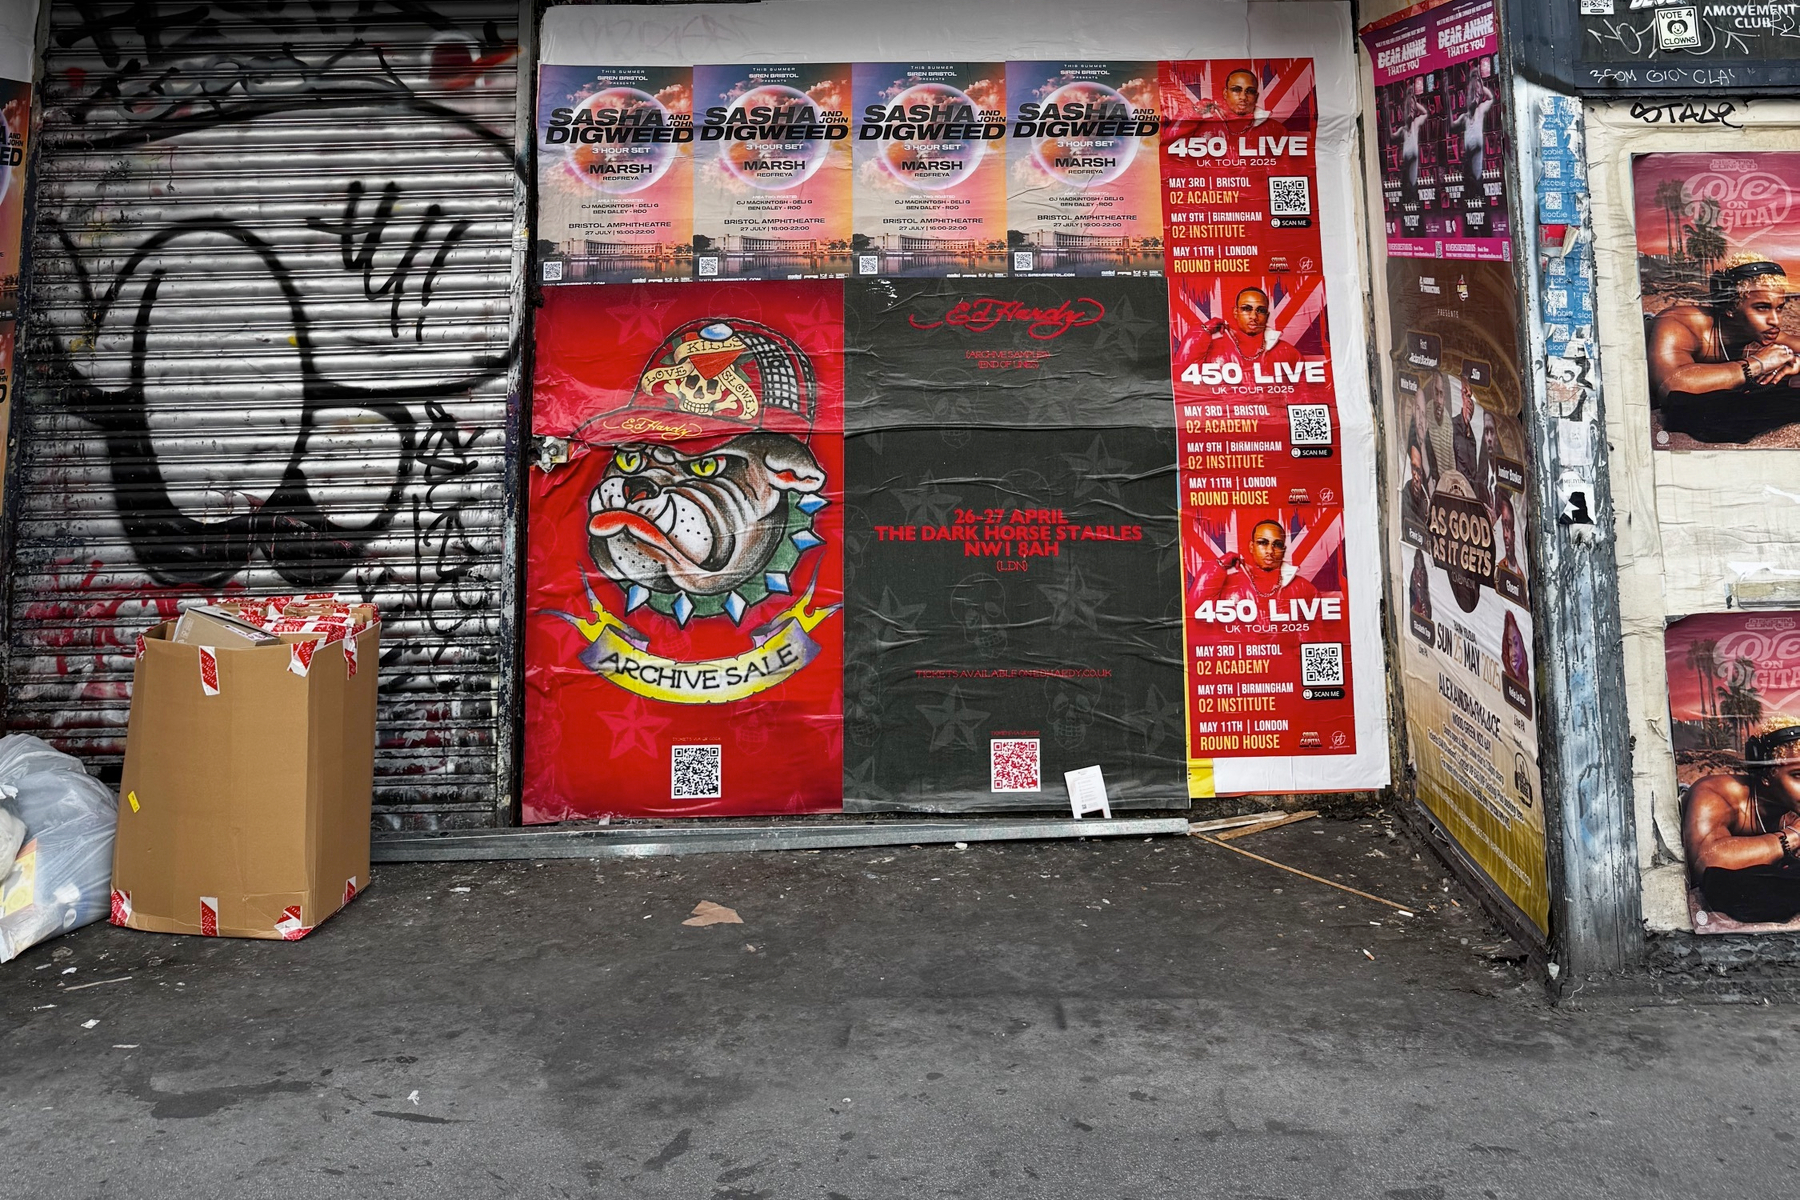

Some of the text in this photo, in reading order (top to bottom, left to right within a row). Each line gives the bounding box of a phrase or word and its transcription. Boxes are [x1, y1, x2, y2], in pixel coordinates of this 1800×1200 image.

[1660, 11, 1682, 19] VOTE
[1735, 18, 1771, 28] CLUB
[1471, 38, 1486, 51] YOU
[1664, 37, 1696, 45] CLOWNS
[549, 108, 663, 126] SASHA
[704, 107, 816, 125] SASHA
[864, 105, 975, 123] SASHA
[1018, 103, 1129, 121] SASHA
[545, 127, 693, 144] DIGWEED
[700, 125, 848, 141] DIGWEED
[859, 124, 1006, 140] DIGWEED
[1013, 122, 1160, 138] DIGWEED
[7, 139, 23, 147] JOHN
[1168, 136, 1307, 157] 450 LIVE
[590, 164, 652, 174] MARSH
[744, 161, 805, 170] MARSH
[902, 161, 962, 170] MARSH
[1055, 158, 1115, 167] MARSH
[1169, 177, 1251, 188] MAY 3RD BRISTOL
[1188, 191, 1239, 204] ACADEMY
[1171, 212, 1262, 223] MAY 9TH BIRMINGHAM
[1190, 225, 1245, 238] INSTITUTE
[1173, 246, 1258, 256] MAY 11TH LONDON
[1174, 259, 1250, 273] ROUND HOUSE
[993, 300, 1085, 340] Hardy
[687, 338, 744, 353] KILLS
[645, 366, 687, 386] LOVE
[1181, 362, 1325, 385] 450 LIVE
[722, 370, 756, 419] SLOWLY
[1234, 405, 1270, 416] BRISTOL
[646, 421, 702, 440] Hardy
[1231, 442, 1282, 452] BIRMINGHAM
[1243, 477, 1277, 487] LONDON
[1190, 491, 1269, 506] ROUND HOUSE
[954, 509, 1068, 524] 26-27 APRIL
[874, 526, 1142, 541] THE DARK HORSE STABLES
[1429, 505, 1491, 548] AS GOOD
[964, 542, 1058, 557] NW1 8AH
[1433, 536, 1491, 577] AS IT GETS
[1194, 598, 1341, 623] 450 LIVE
[1225, 625, 1241, 633] UK
[1281, 623, 1309, 632] 2025
[1437, 622, 1452, 657] SUN
[1195, 644, 1282, 657] MAY 3RD BRISTOL
[598, 643, 799, 689] ARCHIVE SALE
[1464, 641, 1480, 677] MAY
[1761, 660, 1783, 669] ON
[1216, 660, 1269, 674] ACADEMY
[1198, 682, 1293, 695] MAY 9TH BIRMINGHAM
[1218, 697, 1275, 712] INSTITUTE
[1200, 720, 1288, 733] MAY 11TH LONDON
[1200, 734, 1280, 750] ROUND HOUSE
